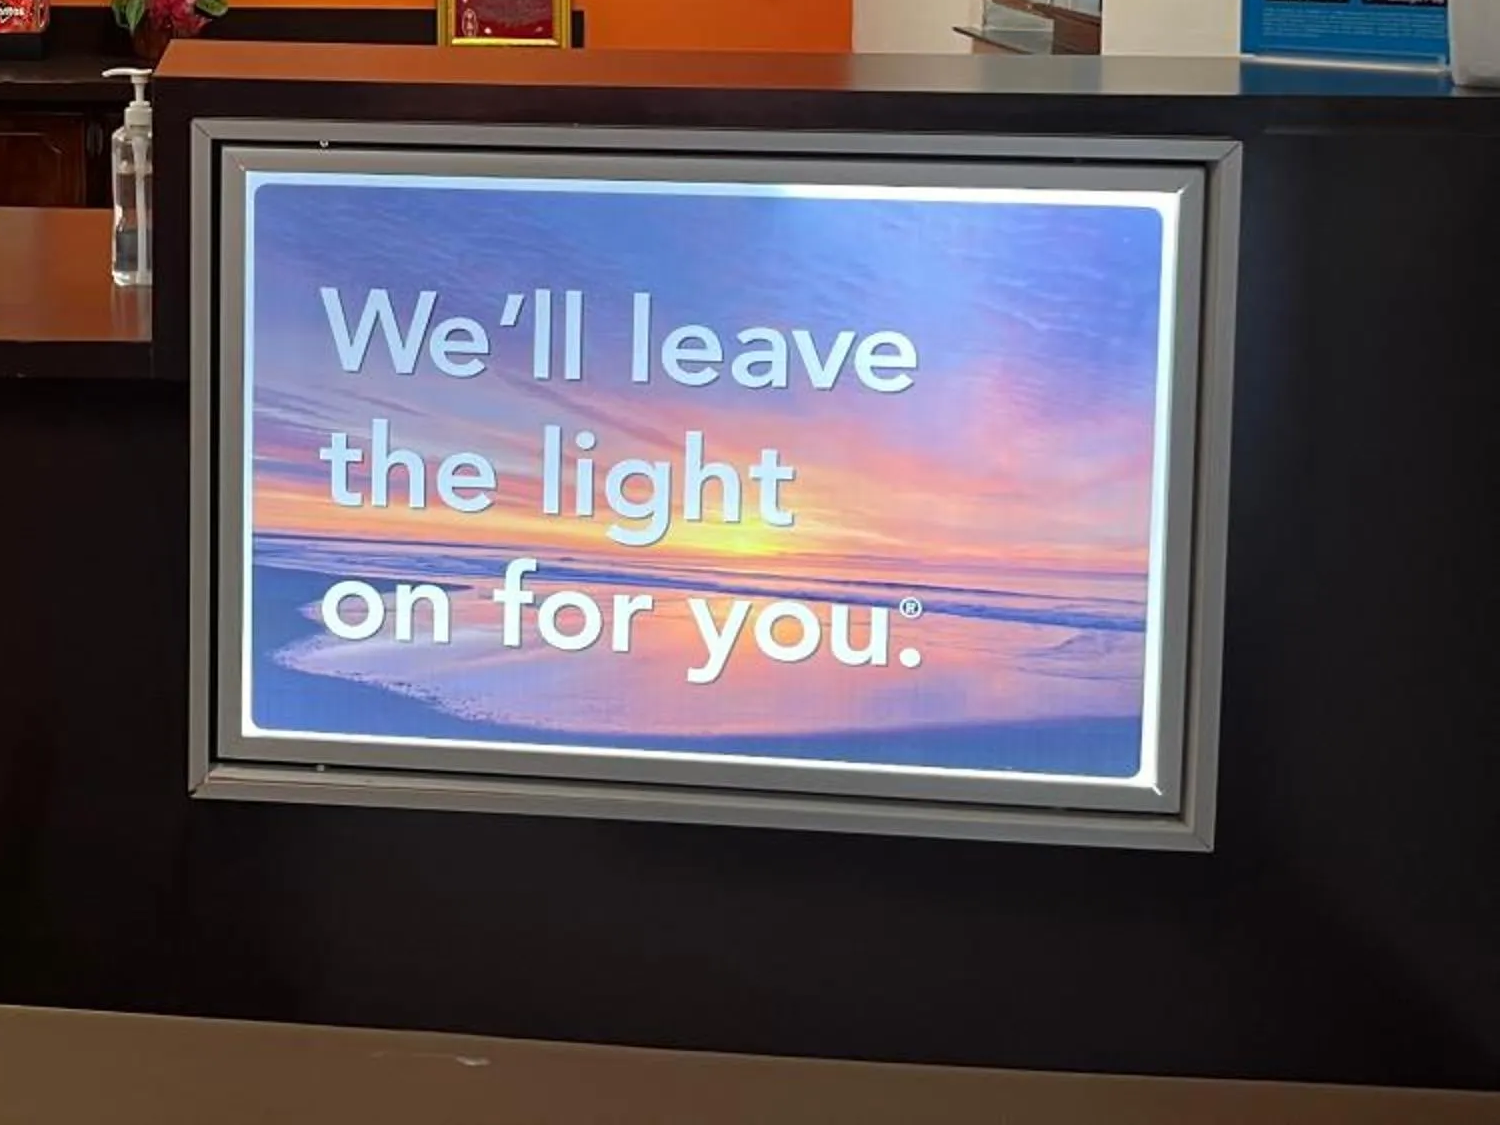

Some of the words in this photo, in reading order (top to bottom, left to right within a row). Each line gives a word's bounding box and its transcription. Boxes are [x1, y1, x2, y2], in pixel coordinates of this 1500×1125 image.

[320, 286, 584, 381] We'll
[632, 291, 918, 393] leave
[319, 418, 497, 512] the
[542, 425, 796, 546] light
[320, 579, 452, 645] on
[493, 558, 653, 653] for
